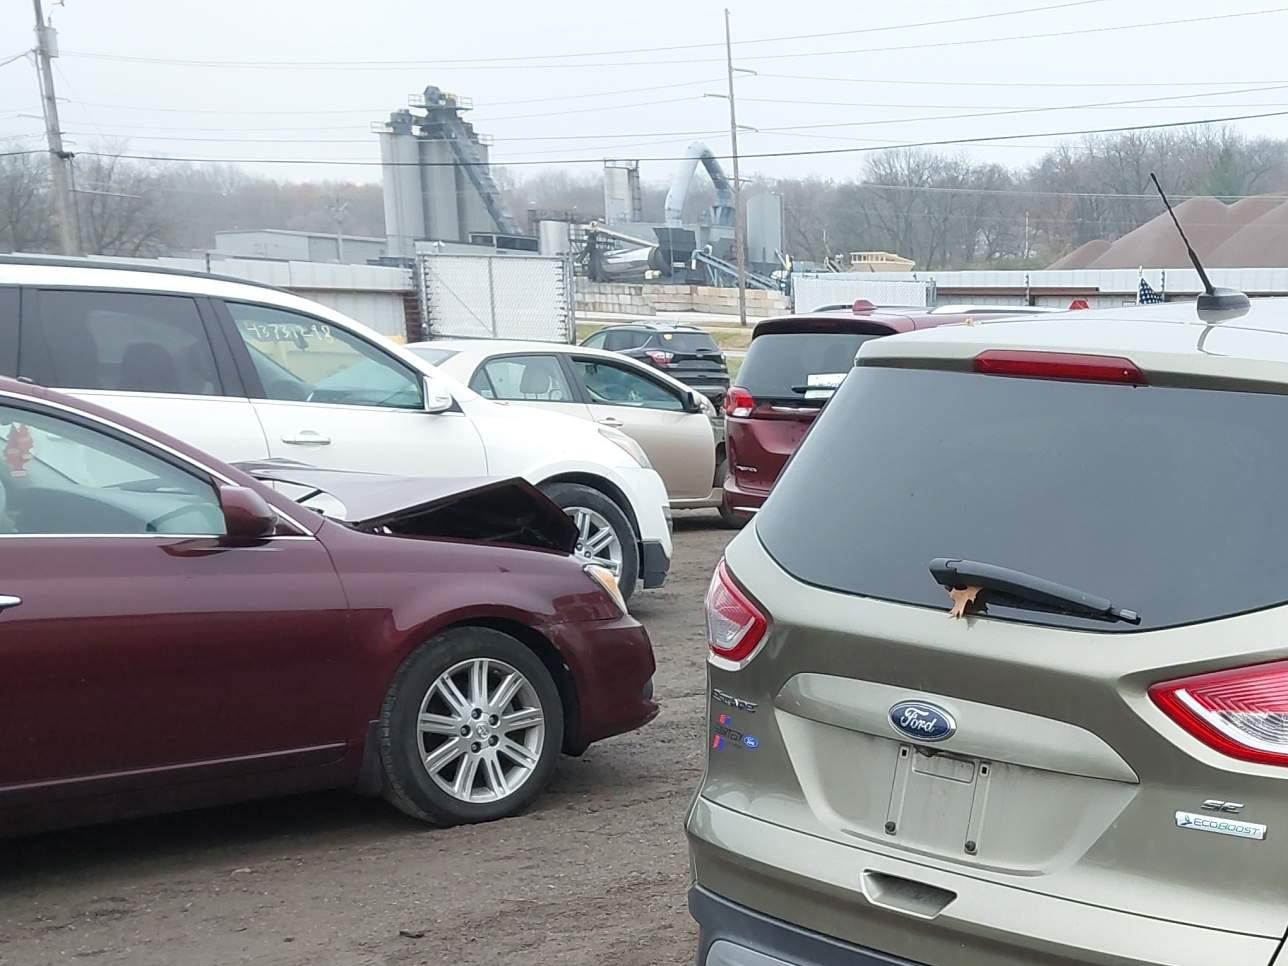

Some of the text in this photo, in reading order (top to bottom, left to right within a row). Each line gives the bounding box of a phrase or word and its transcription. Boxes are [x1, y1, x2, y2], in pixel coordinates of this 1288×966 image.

[900, 707, 938, 734] Ford
[1200, 799, 1246, 814] SE
[1193, 817, 1260, 836] ECOBOOST
